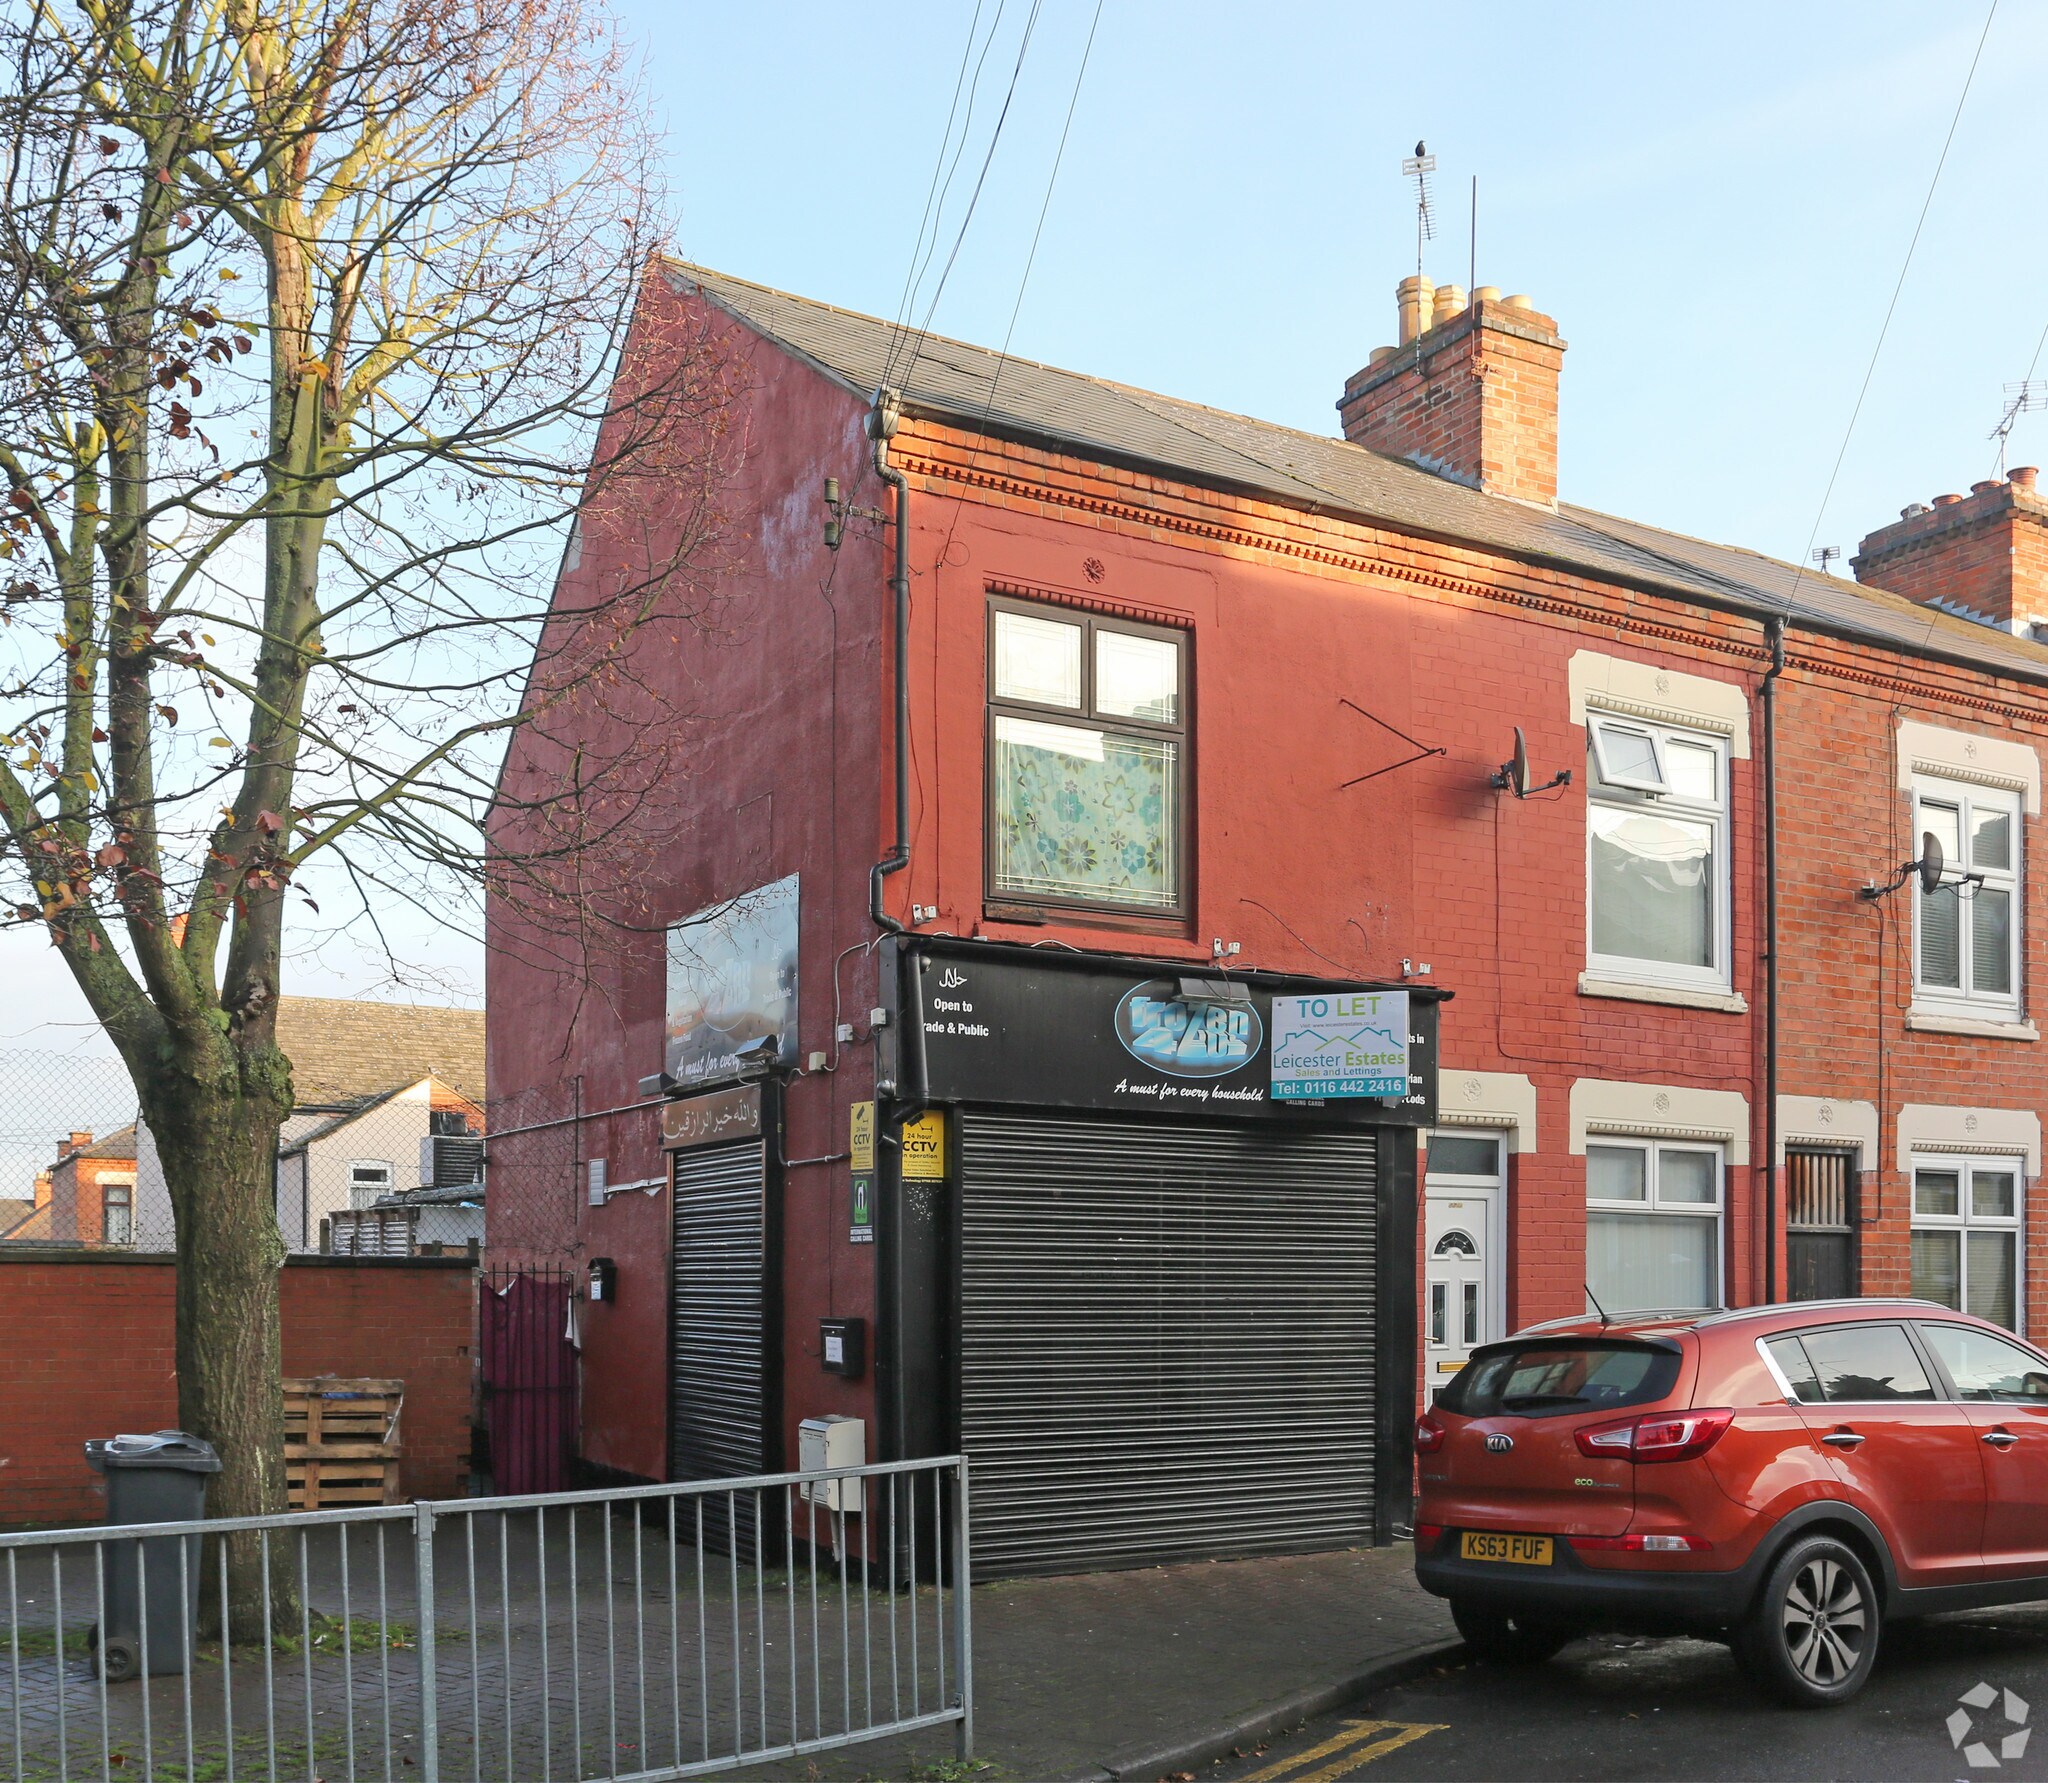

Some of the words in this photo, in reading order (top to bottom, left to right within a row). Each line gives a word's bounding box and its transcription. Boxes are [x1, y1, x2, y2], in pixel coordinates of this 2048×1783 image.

[934, 998, 960, 1012] Open
[963, 1001, 973, 1012] to
[1297, 998, 1328, 1018] TO
[1337, 996, 1381, 1016] LET
[923, 1021, 945, 1033] rade
[947, 1022, 956, 1034] &
[958, 1023, 989, 1036] Public
[1417, 1034, 1425, 1044] in
[685, 1056, 704, 1075] must
[705, 1051, 719, 1077] for
[719, 1053, 740, 1073] every
[1273, 1054, 1341, 1068] Leicester
[1345, 1052, 1405, 1066] Estates
[1295, 1069, 1320, 1077] Sales
[1323, 1068, 1341, 1076] and
[1343, 1067, 1382, 1077] Lettings
[1114, 1078, 1127, 1093] A
[1130, 1082, 1158, 1095] must
[1159, 1082, 1178, 1100] for
[1181, 1087, 1209, 1102] every
[1212, 1085, 1264, 1101] household
[1276, 1083, 1300, 1094] Tel:
[1304, 1082, 1336, 1094] 0116
[1339, 1080, 1365, 1093] 442
[1368, 1079, 1402, 1093] 2416
[854, 1133, 871, 1144] CCTV
[903, 1141, 937, 1152] CCTV
[1487, 1438, 1507, 1450] KIA
[1468, 1535, 1507, 1557] KS63
[1512, 1539, 1545, 1559] FUF
